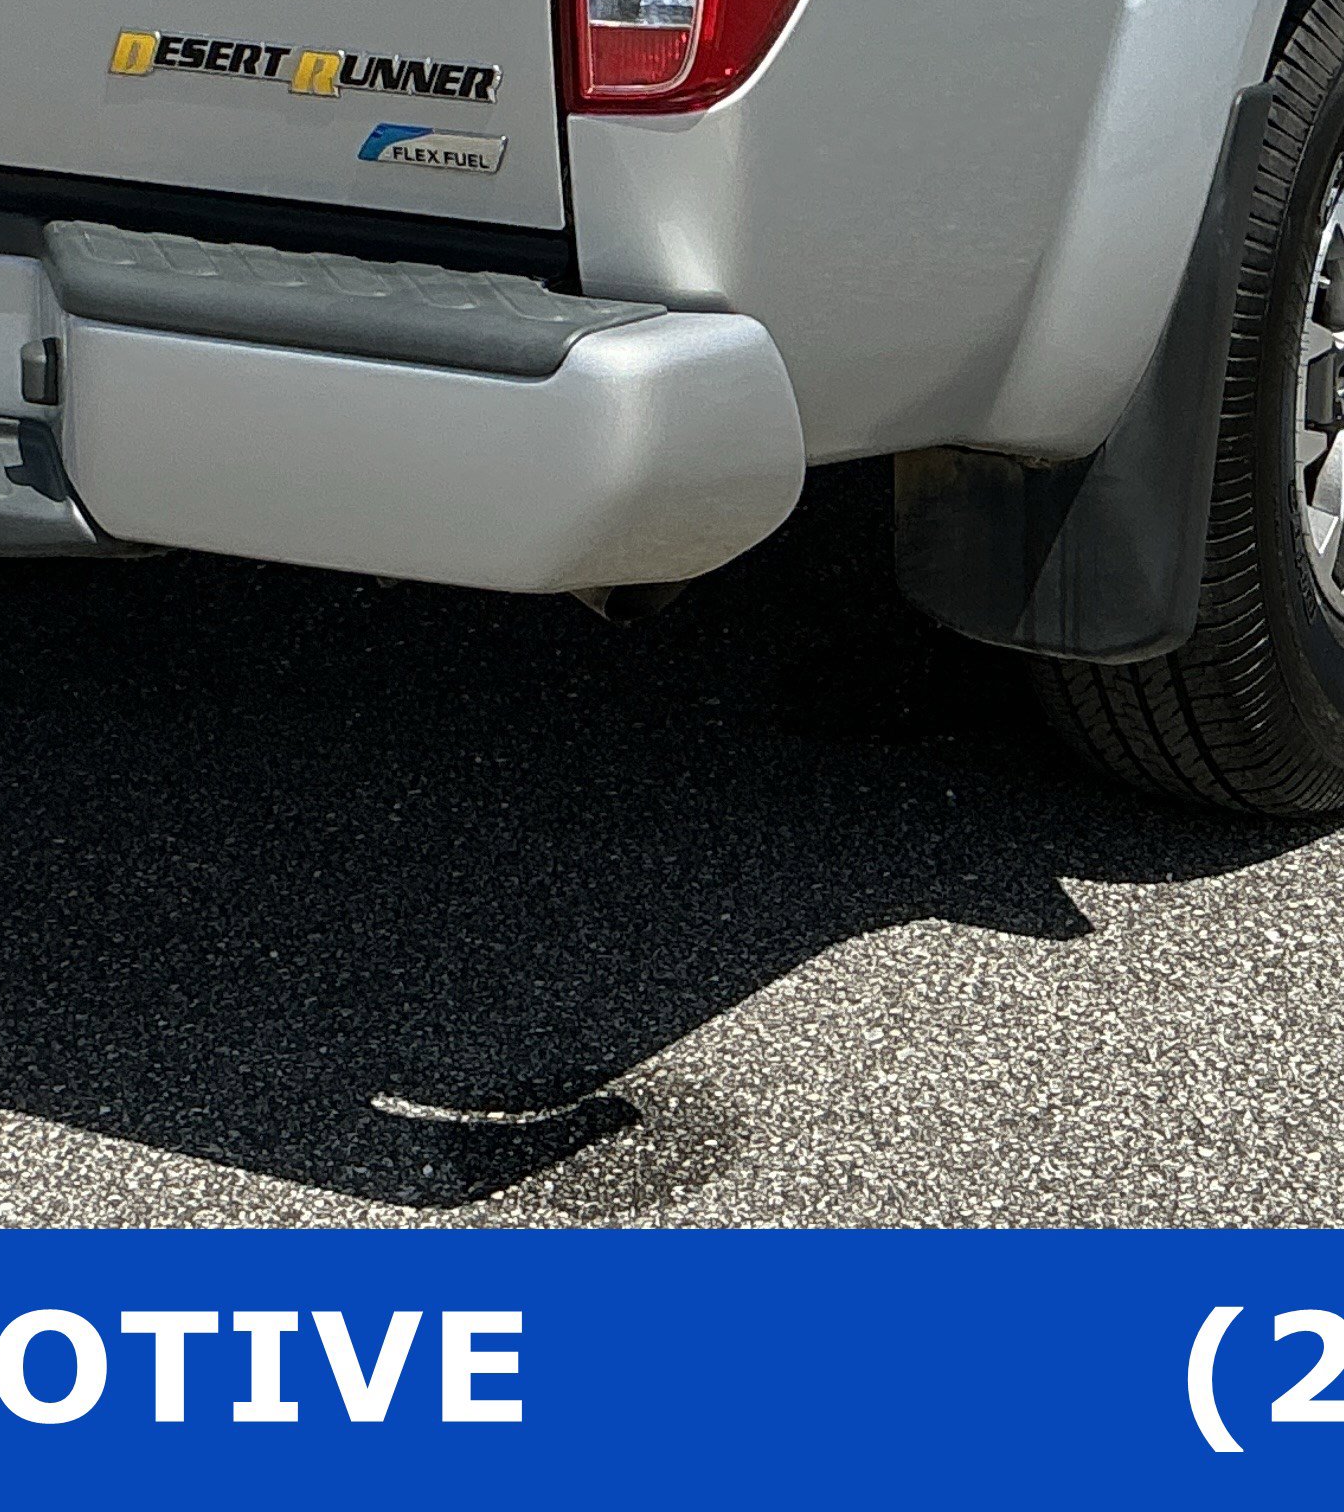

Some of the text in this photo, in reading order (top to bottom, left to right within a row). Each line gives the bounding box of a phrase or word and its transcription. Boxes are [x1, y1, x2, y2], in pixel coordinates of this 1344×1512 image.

[109, 30, 499, 99] DESERT RUNNER
[392, 146, 490, 170] FLEX FUEL
